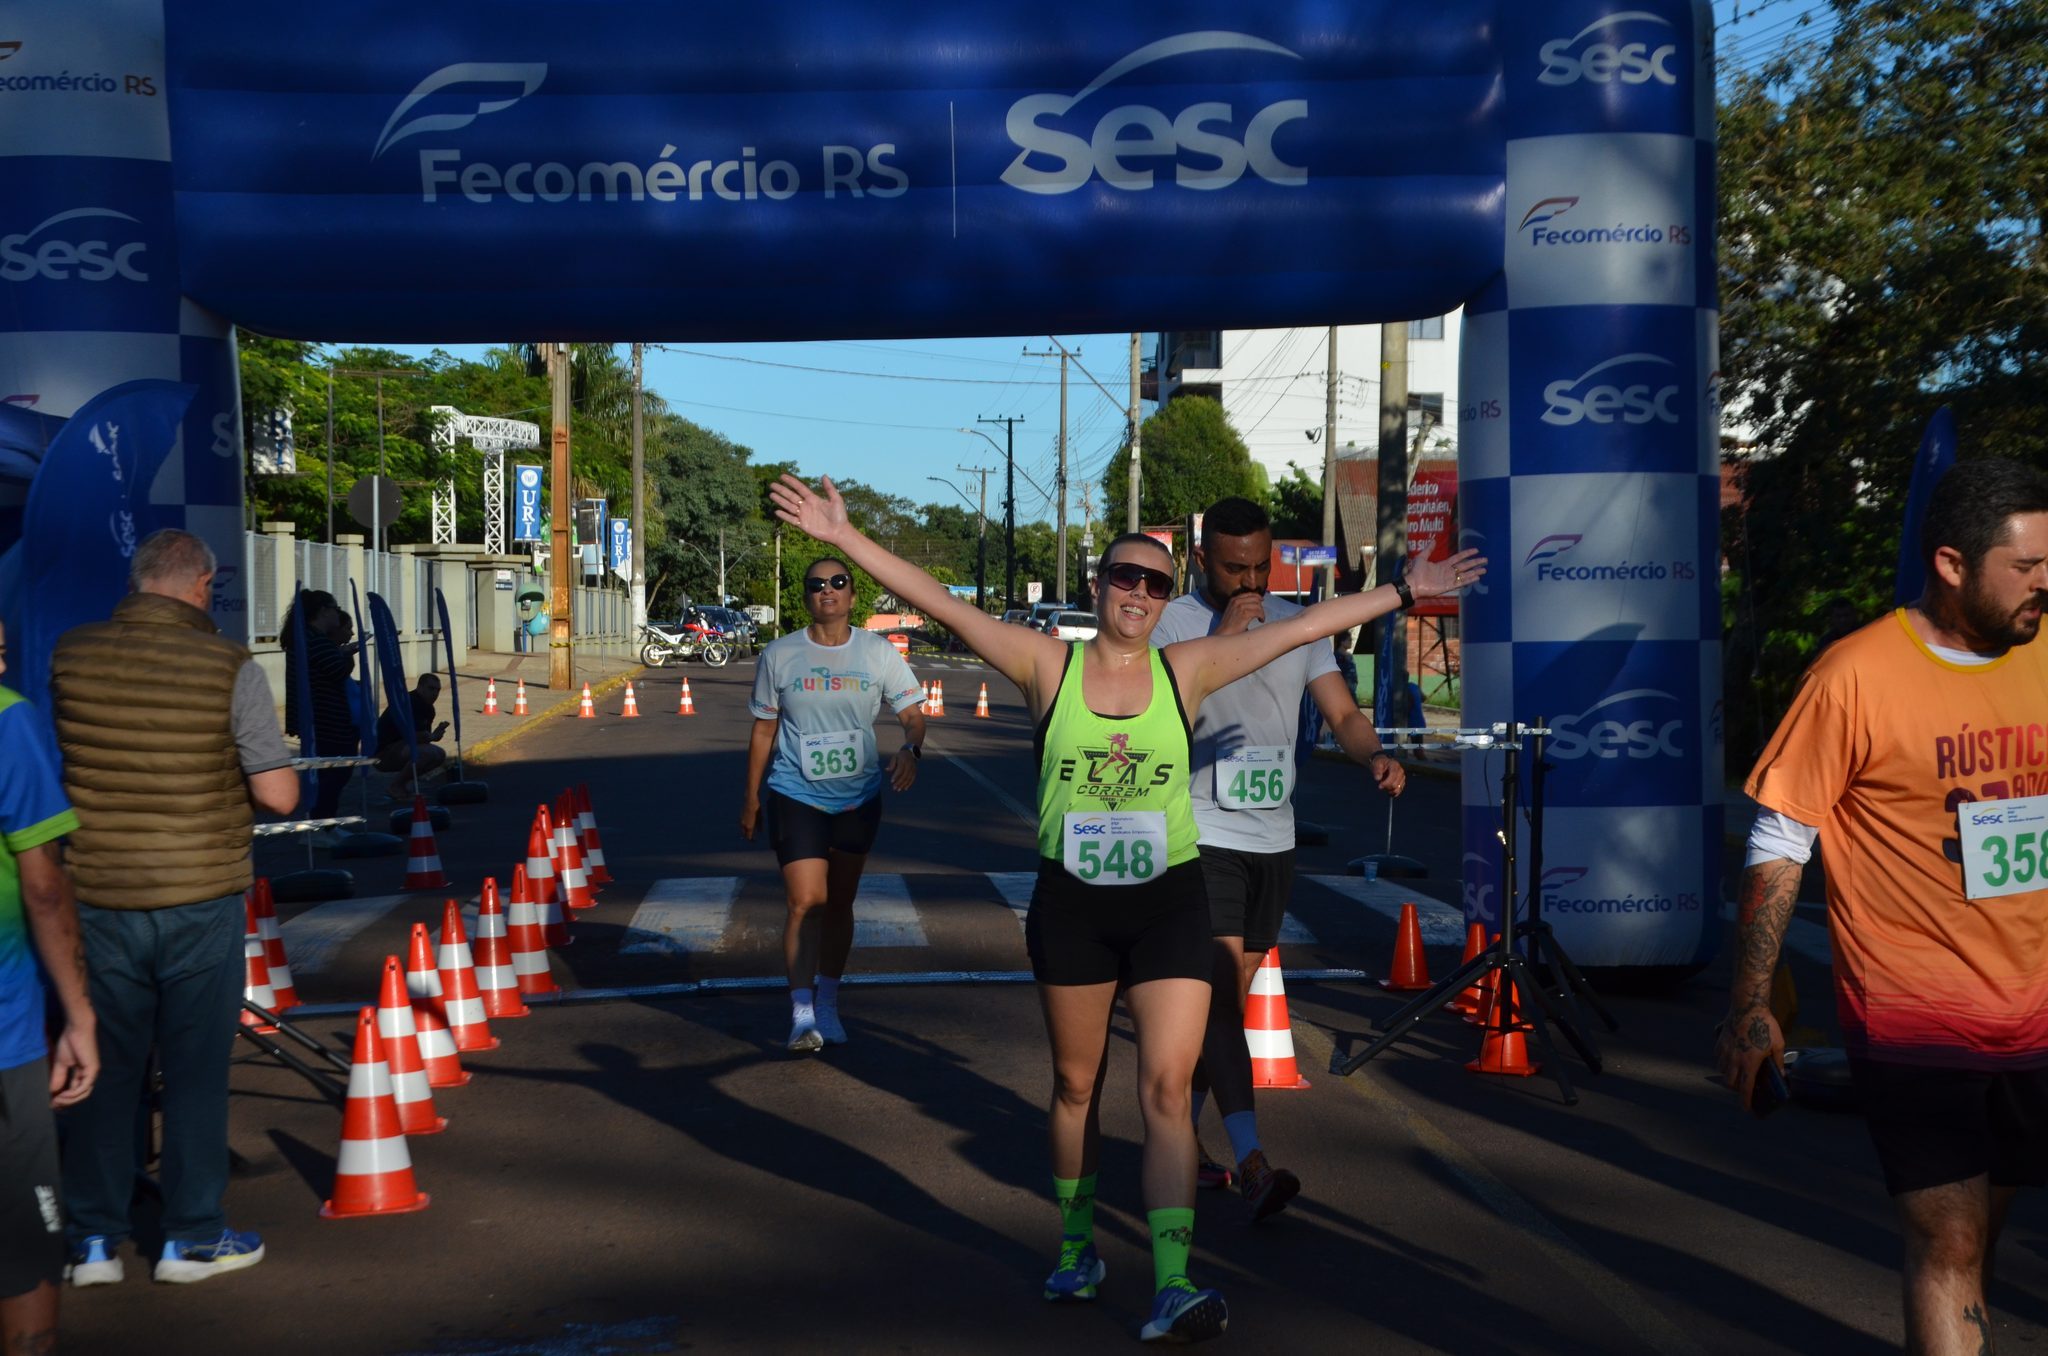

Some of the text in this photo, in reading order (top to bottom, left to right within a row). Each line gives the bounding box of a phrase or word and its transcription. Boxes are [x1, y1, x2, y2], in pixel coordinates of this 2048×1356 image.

[1536, 38, 1677, 85] Sesc
[125, 75, 157, 96] RS
[1000, 93, 1308, 195] Sesc
[419, 143, 909, 203] Fecomércio RS
[1533, 223, 1692, 247] Fecomércio RS
[1540, 379, 1679, 426] Sesc
[522, 490, 537, 538] URI
[615, 534, 625, 566] URI
[1538, 560, 1696, 581] Fecomércio RS
[1545, 715, 1684, 759] Sesc
[1935, 723, 2048, 780] RÚSTIC
[810, 747, 858, 776] 363
[1076, 785, 1150, 798] CORREM
[1228, 769, 1284, 803] 456
[1078, 839, 1154, 879] 548
[1543, 893, 1700, 913] Fecomércio RS
